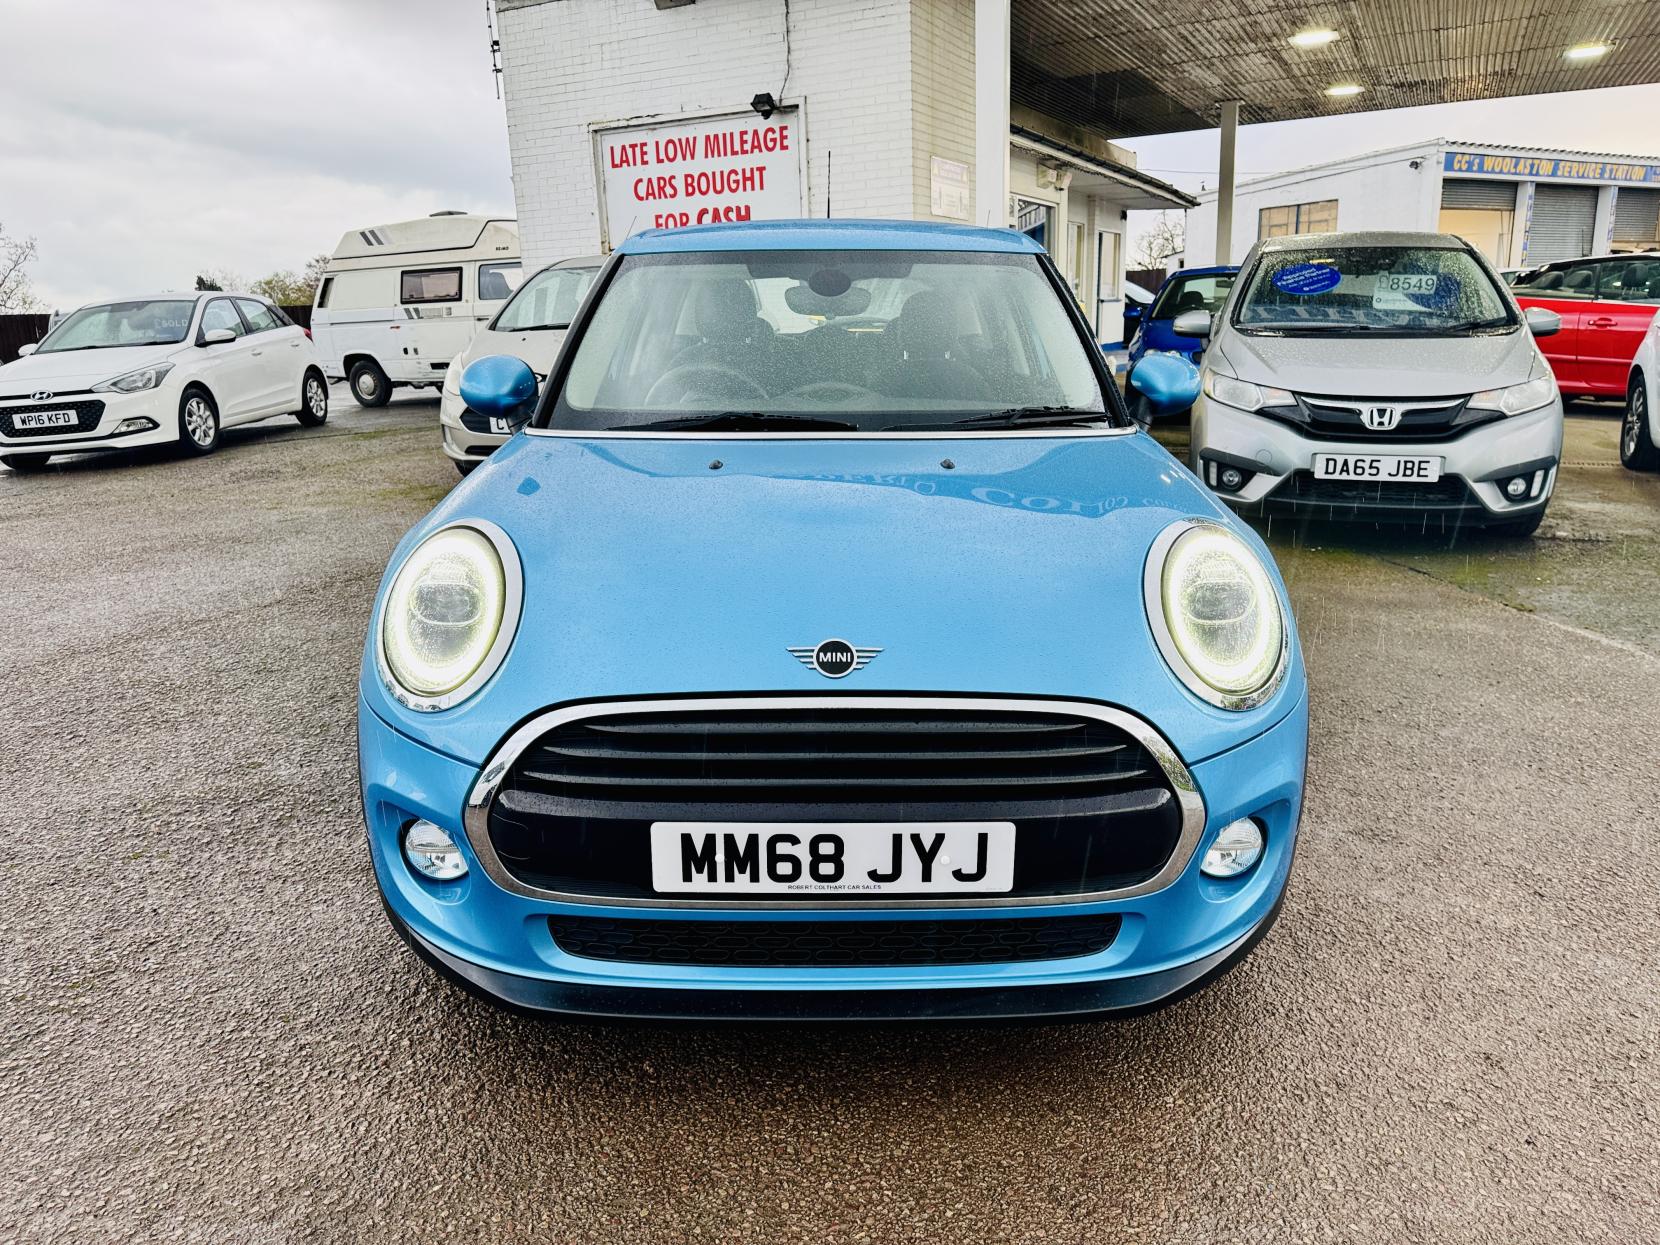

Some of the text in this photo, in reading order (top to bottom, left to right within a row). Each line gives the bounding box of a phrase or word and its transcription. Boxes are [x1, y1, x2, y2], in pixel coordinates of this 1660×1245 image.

[610, 125, 789, 169] LATE LOW MILEAGE
[1483, 155, 1554, 175] WOOLASTON
[1557, 159, 1602, 178] SERVICE
[1604, 163, 1646, 180] STATION
[633, 166, 766, 202] CARS BOUGHT
[696, 205, 751, 225] CASH
[20, 412, 71, 426] WP16 KFD
[1324, 458, 1431, 478] DA65 JBE
[819, 652, 851, 662] MINI
[680, 832, 988, 883] MM68 JYJ
